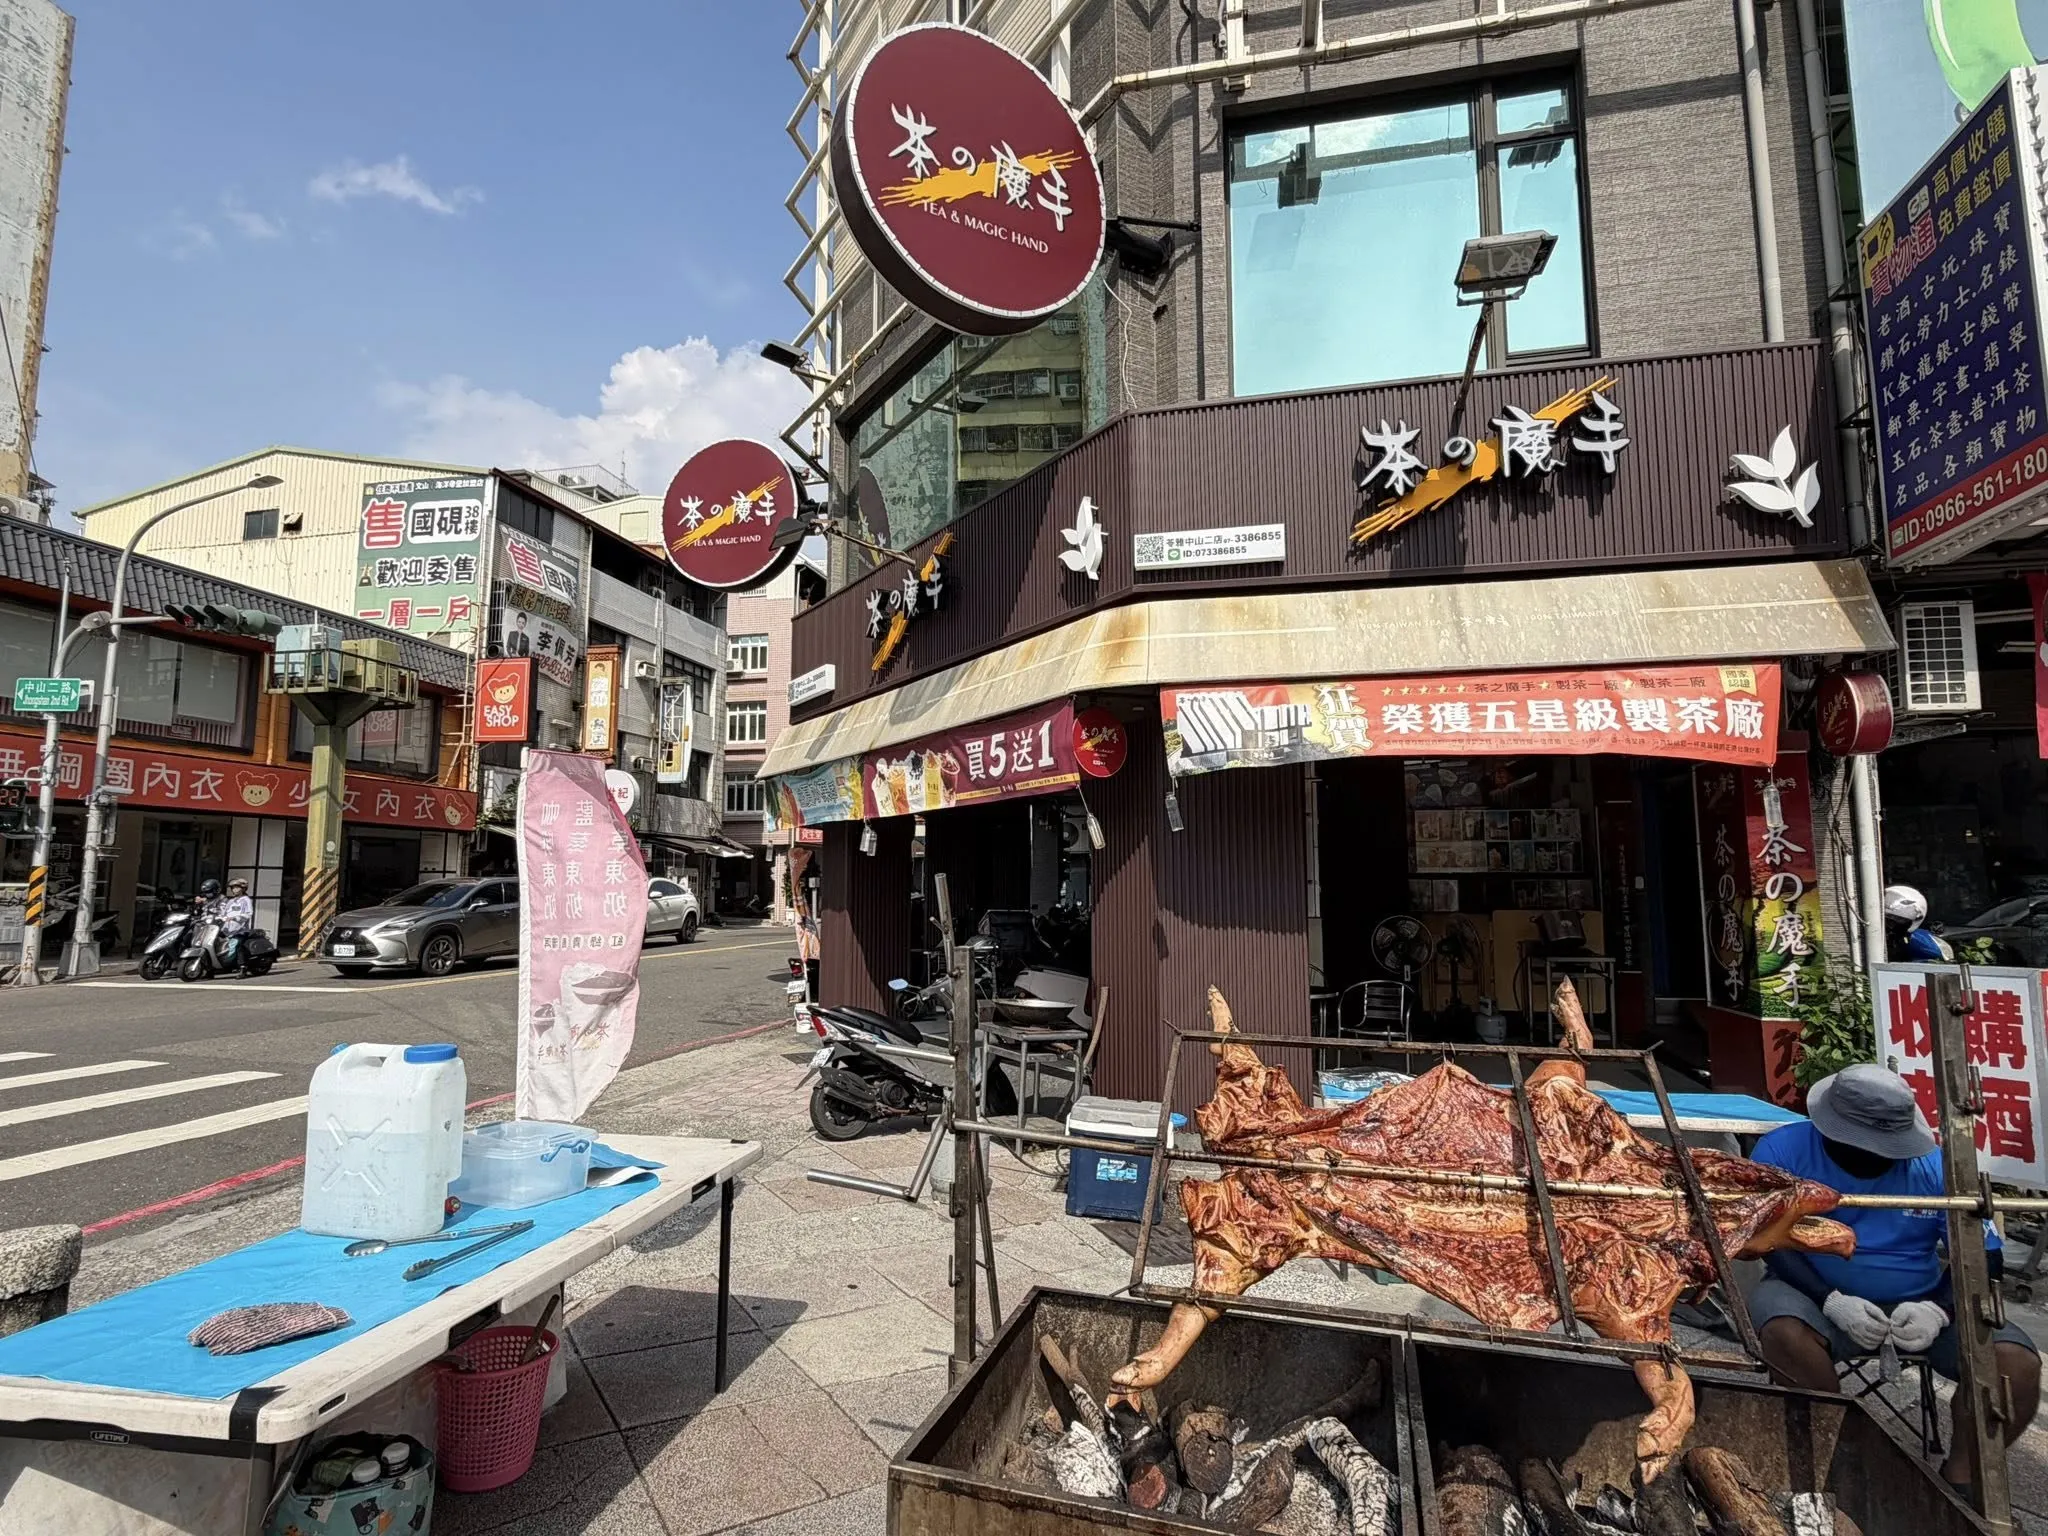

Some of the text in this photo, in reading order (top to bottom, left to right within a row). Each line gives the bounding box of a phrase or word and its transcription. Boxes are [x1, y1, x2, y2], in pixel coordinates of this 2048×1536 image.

[922, 200, 1049, 254] TEA & MAGIC HAND
[1360, 391, 1631, 496] 茶の魔手
[362, 498, 406, 548] 售
[464, 505, 480, 519] 38
[464, 519, 479, 535] 樓
[716, 537, 739, 545] MAGIC
[741, 534, 761, 543] HAND
[376, 555, 476, 586] 歡迎委售
[506, 538, 545, 588] 售
[24, 680, 72, 694] 中山二路
[483, 704, 513, 718] EASY
[486, 714, 519, 728] SHOP
[1381, 697, 1765, 739] 榮獲五星級製茶廠
